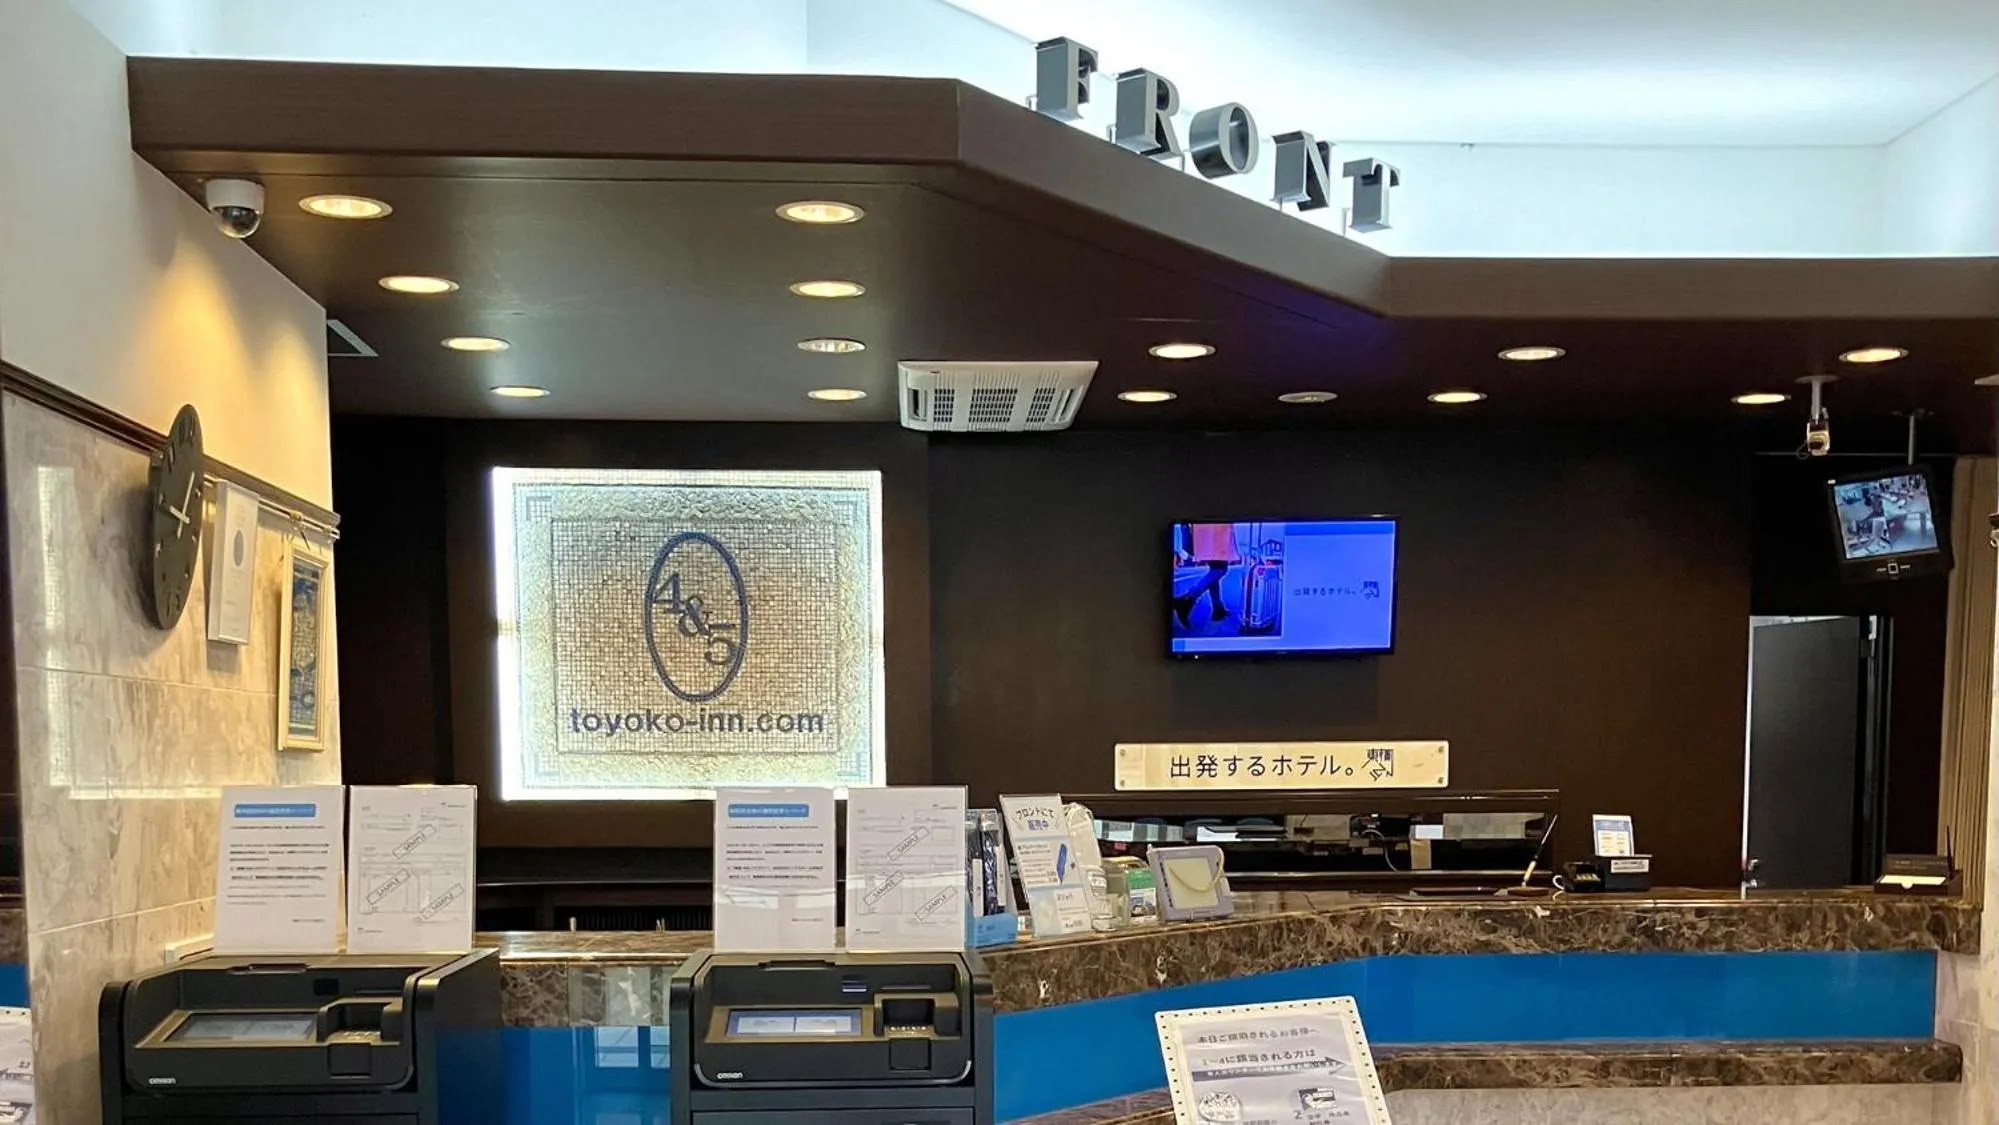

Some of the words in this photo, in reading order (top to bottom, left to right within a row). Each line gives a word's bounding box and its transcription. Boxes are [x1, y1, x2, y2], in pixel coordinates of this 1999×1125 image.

[1033, 36, 1401, 233] FRONT
[569, 708, 825, 737] toyoko-inn.com
[1170, 754, 1354, 779] 出発するホテル。
